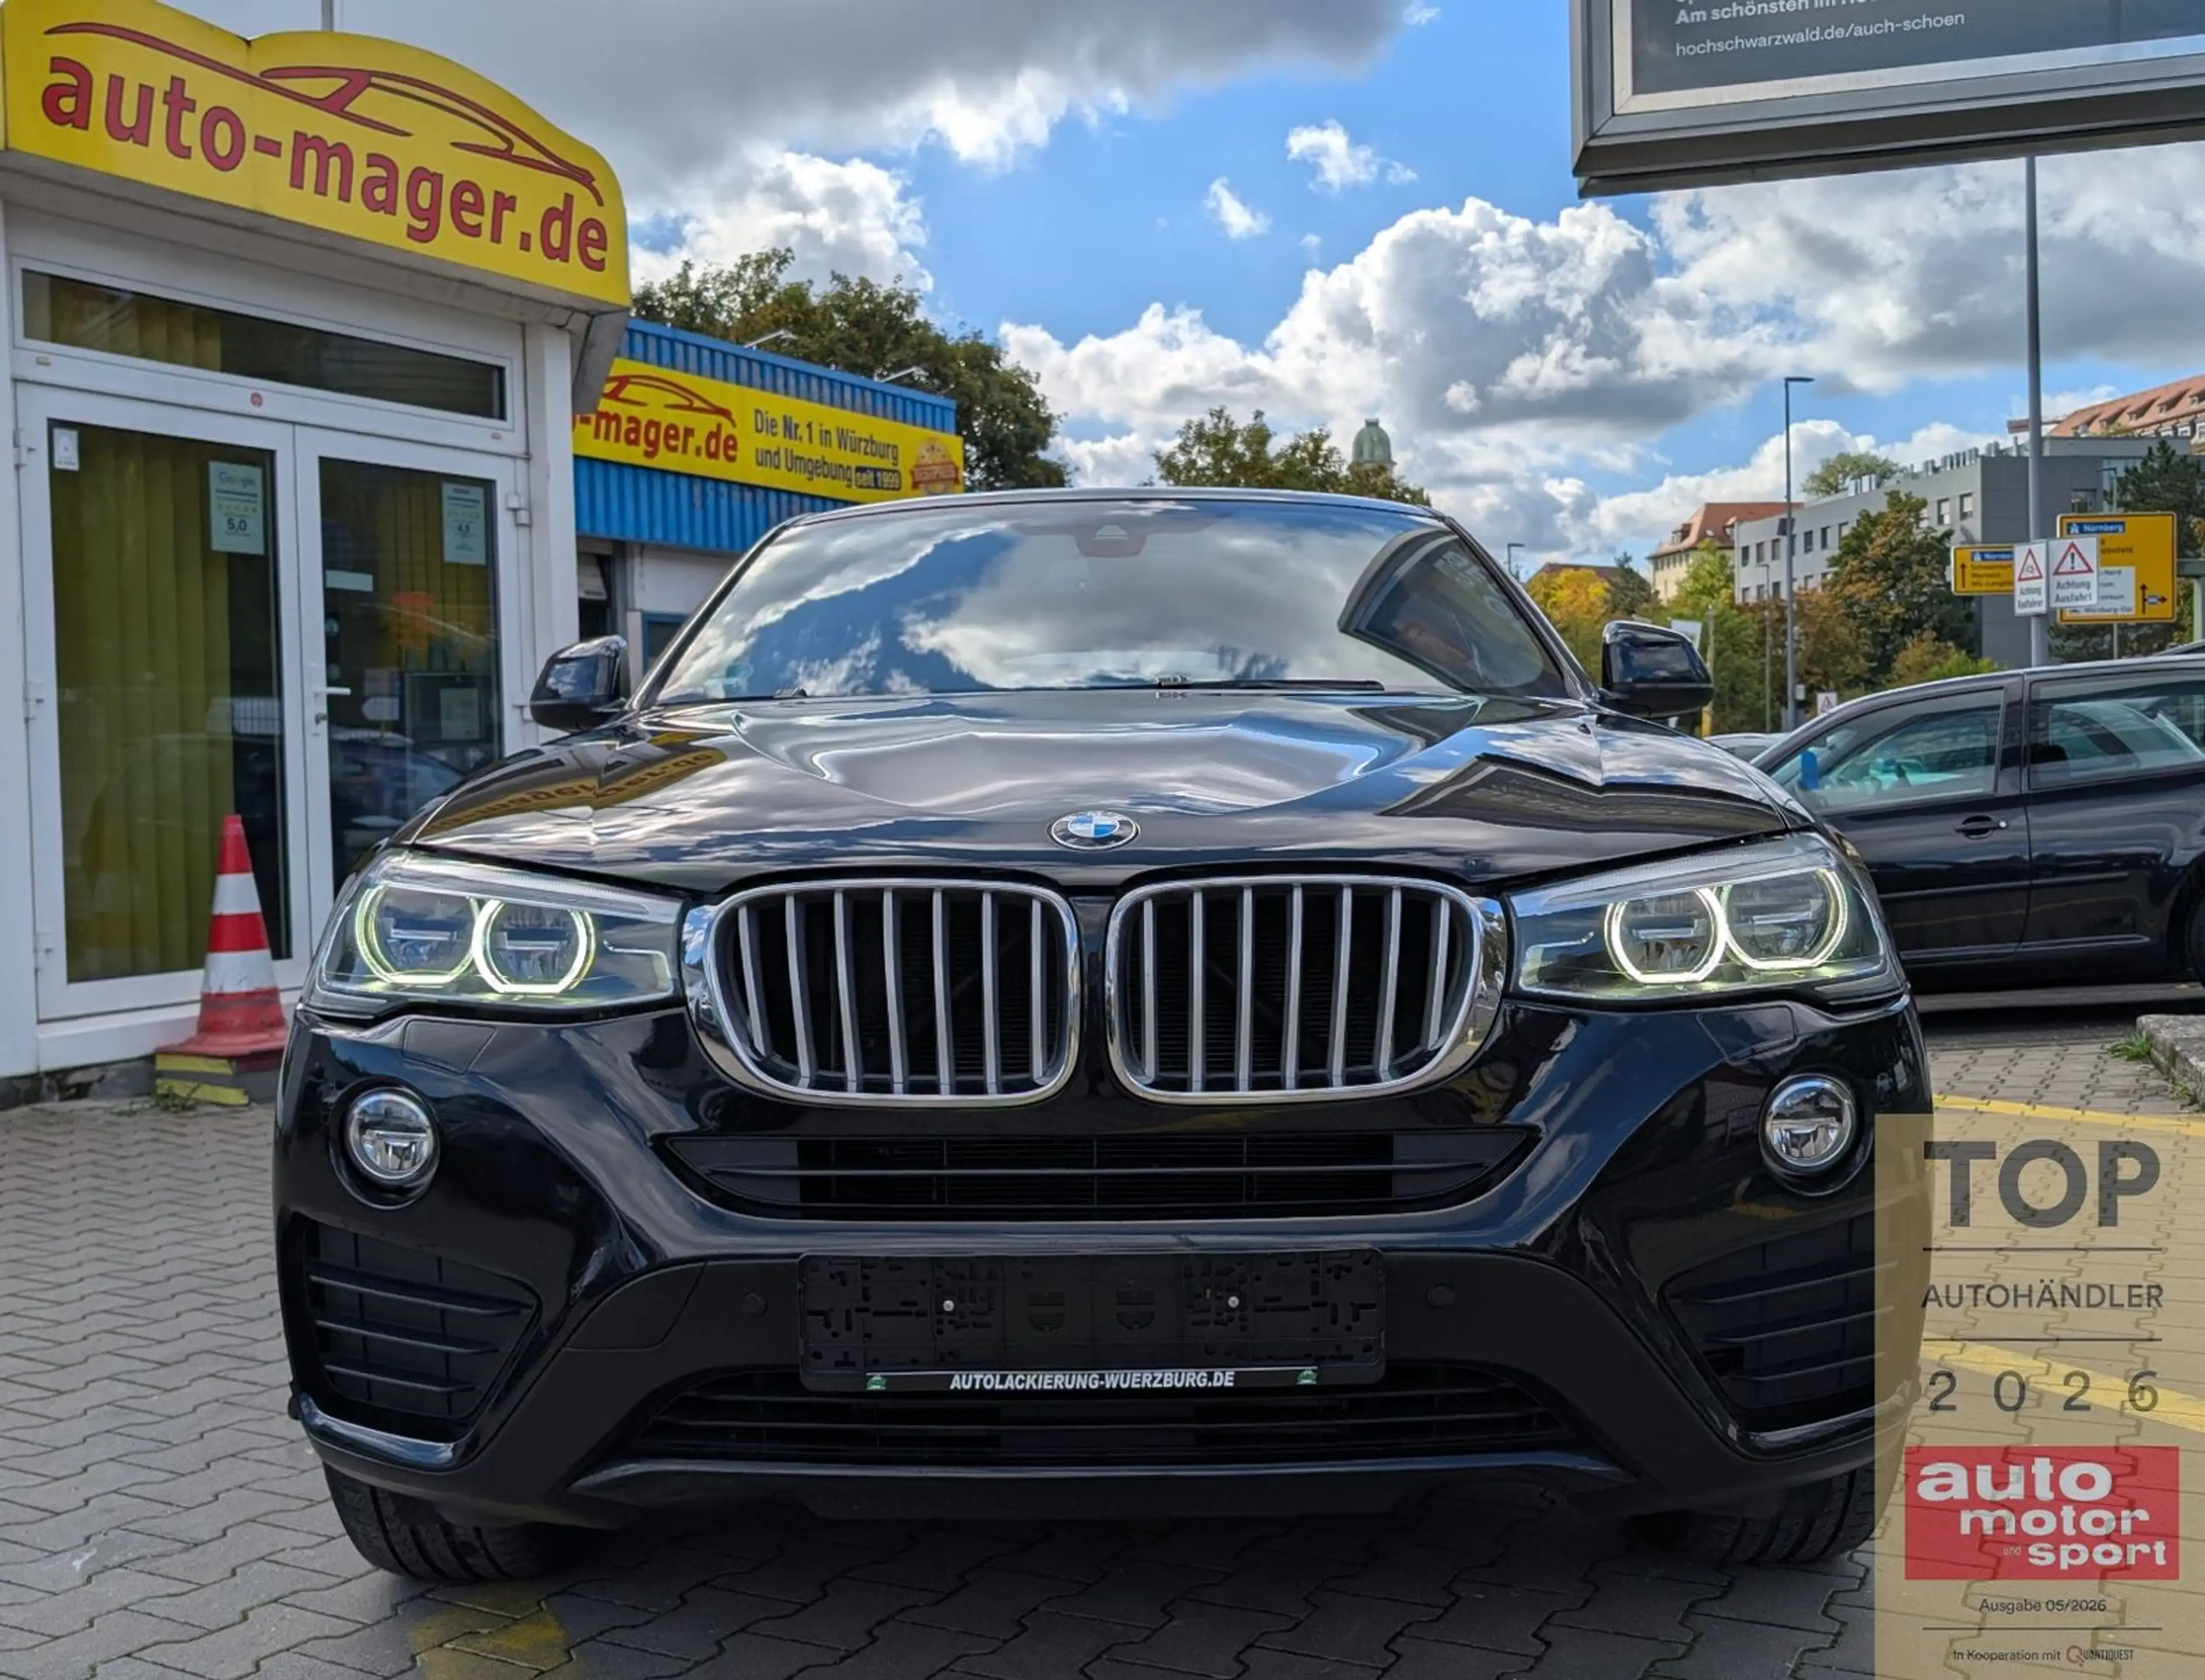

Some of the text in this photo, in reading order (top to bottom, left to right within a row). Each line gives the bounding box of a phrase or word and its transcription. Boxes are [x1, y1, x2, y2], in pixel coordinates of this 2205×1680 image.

[1675, 9, 1707, 24] Am
[1710, 0, 1809, 20] schönsten
[1676, 12, 1965, 57] hochschwarzwald.de/auch-schoen
[41, 57, 608, 272] auto-mager.de
[572, 410, 738, 463] -mager.de
[755, 408, 899, 466] Die Nr. 1 in Würzburg
[755, 448, 780, 467] und
[785, 449, 852, 488] Umgebung
[2056, 580, 2091, 591] Achtung
[950, 1371, 1235, 1390] AUTOLACKIERUNG-WUERZBURG.DE
